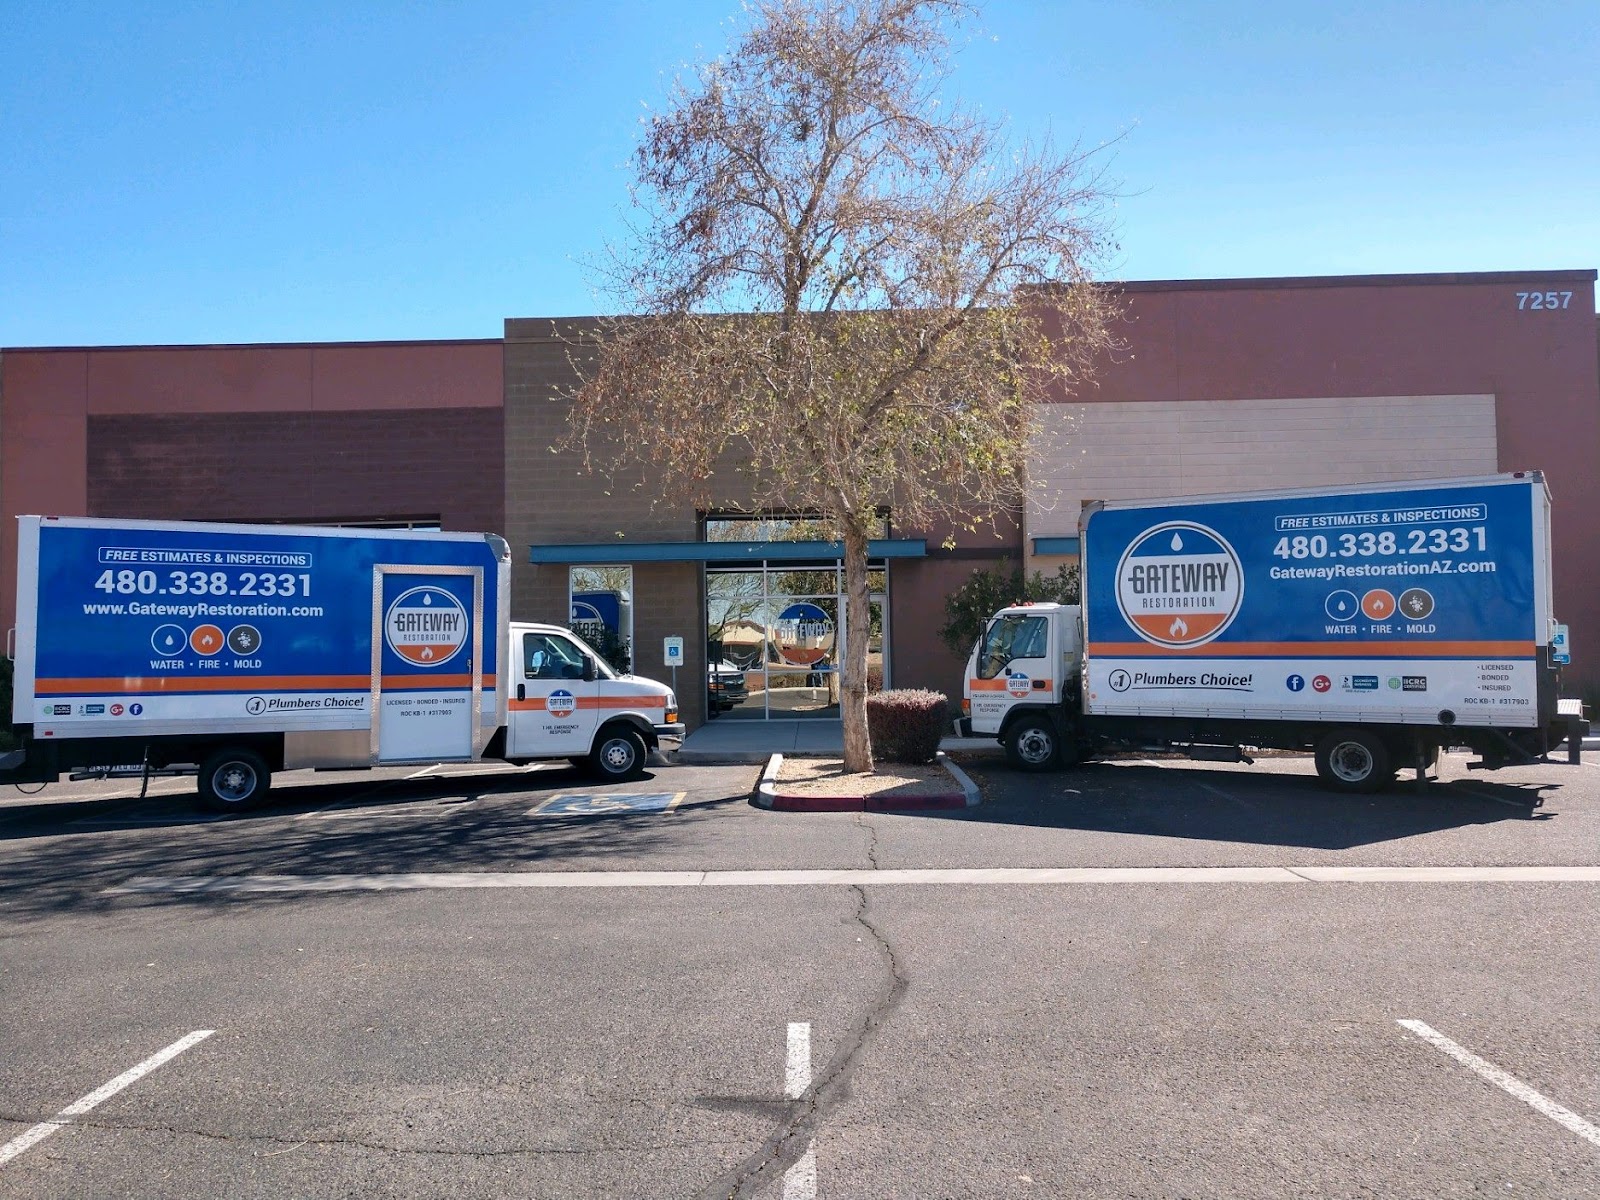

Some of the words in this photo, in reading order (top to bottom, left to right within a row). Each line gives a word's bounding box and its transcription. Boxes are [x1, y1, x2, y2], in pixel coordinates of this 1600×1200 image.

[1516, 291, 1573, 310] 7257
[1280, 517, 1310, 529] FREE
[1312, 513, 1379, 527] ESTIMATES
[1381, 513, 1391, 523] &
[1393, 507, 1481, 522] INSPECTIONS
[1273, 526, 1488, 560] 480.338.2331
[105, 550, 138, 561] FREE
[140, 551, 211, 564] ESTIMATES
[214, 553, 224, 564] &
[226, 553, 307, 566] INSPECTIONS
[1127, 562, 1230, 595] GATEWAY
[1269, 560, 1497, 581] GatewayRestorationAZ.com
[94, 569, 311, 597] 480.338.2331
[83, 601, 324, 619] www.GatewayRestoration.com
[1142, 596, 1216, 609] RESTORATION
[394, 613, 460, 632] GATEWAY
[1324, 625, 1358, 634] WATER
[1370, 624, 1393, 634] FIRE
[1406, 624, 1437, 634] MOLD
[403, 633, 451, 642] RESTORATION
[150, 660, 185, 670] WATER
[198, 659, 220, 669] FIRE
[233, 659, 262, 669] MOLD
[1134, 672, 1197, 686] Plumbers
[1200, 673, 1253, 686] Choice!
[268, 698, 321, 709] Plumbers
[324, 697, 364, 707] Choice!
